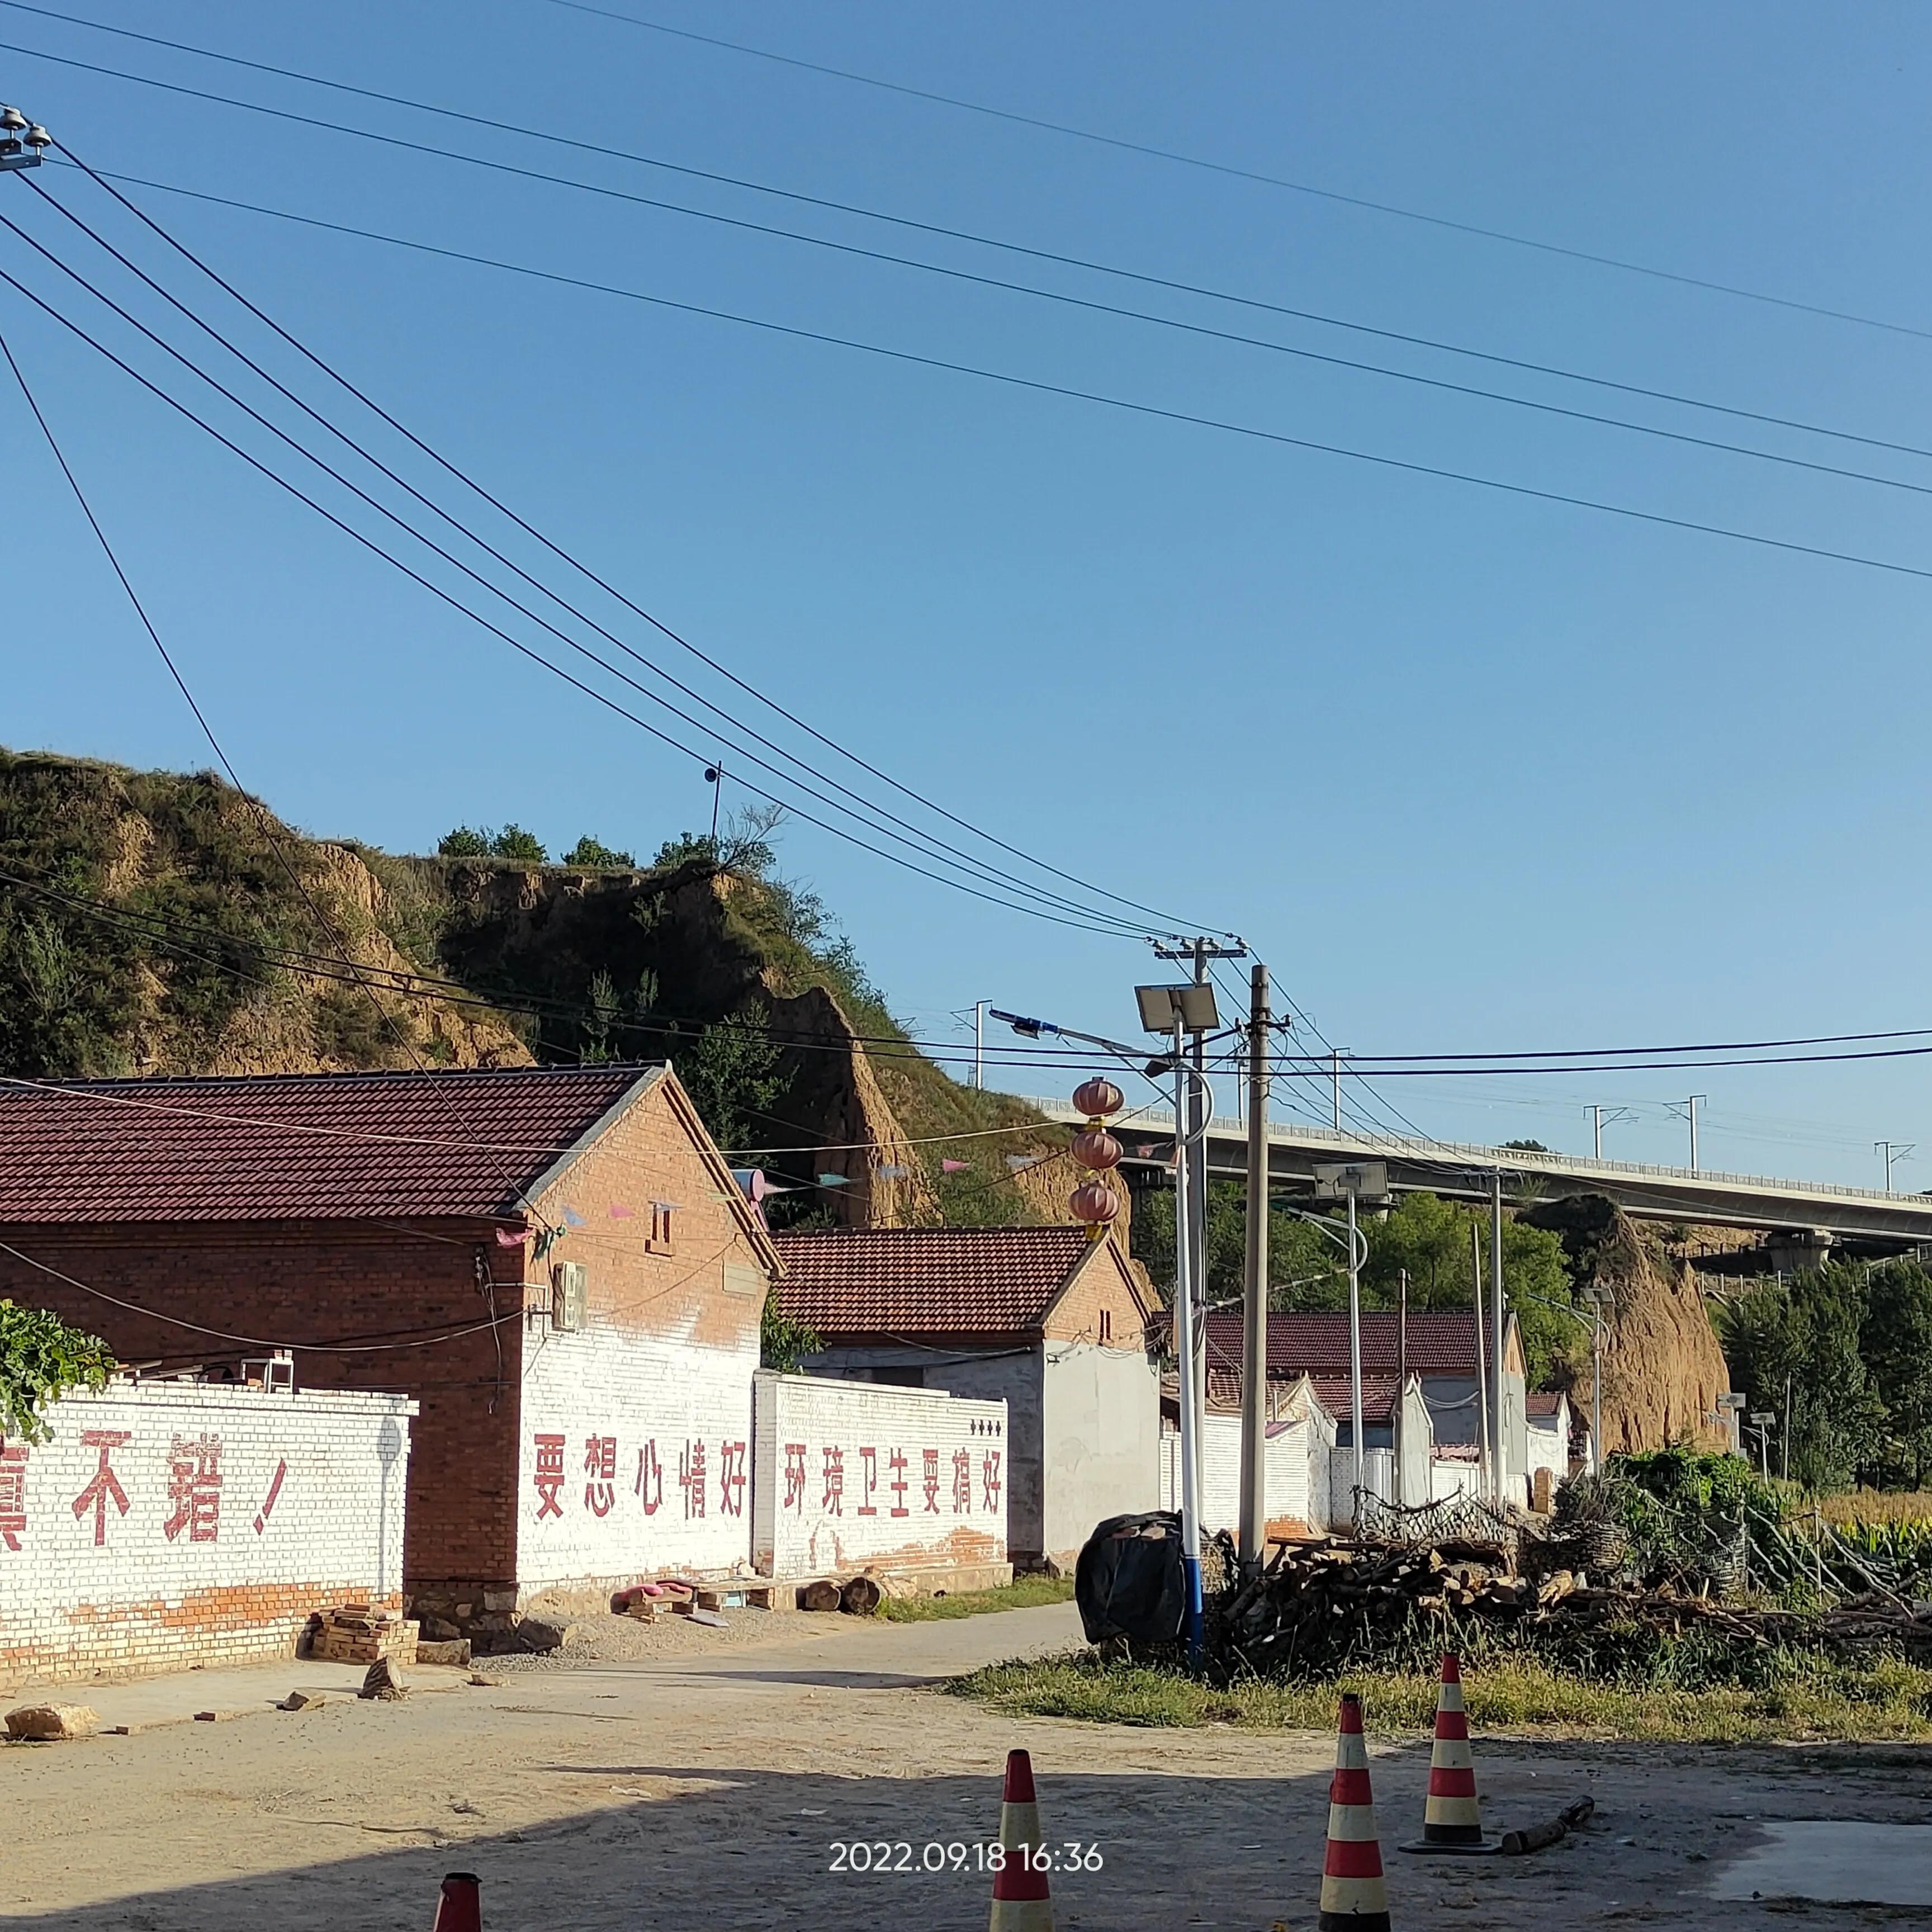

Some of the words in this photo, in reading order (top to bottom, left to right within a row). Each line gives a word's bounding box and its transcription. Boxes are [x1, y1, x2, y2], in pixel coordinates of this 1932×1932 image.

[534, 1433, 746, 1520] 要想心情好
[784, 1444, 1001, 1518] 环境卫生要搞好
